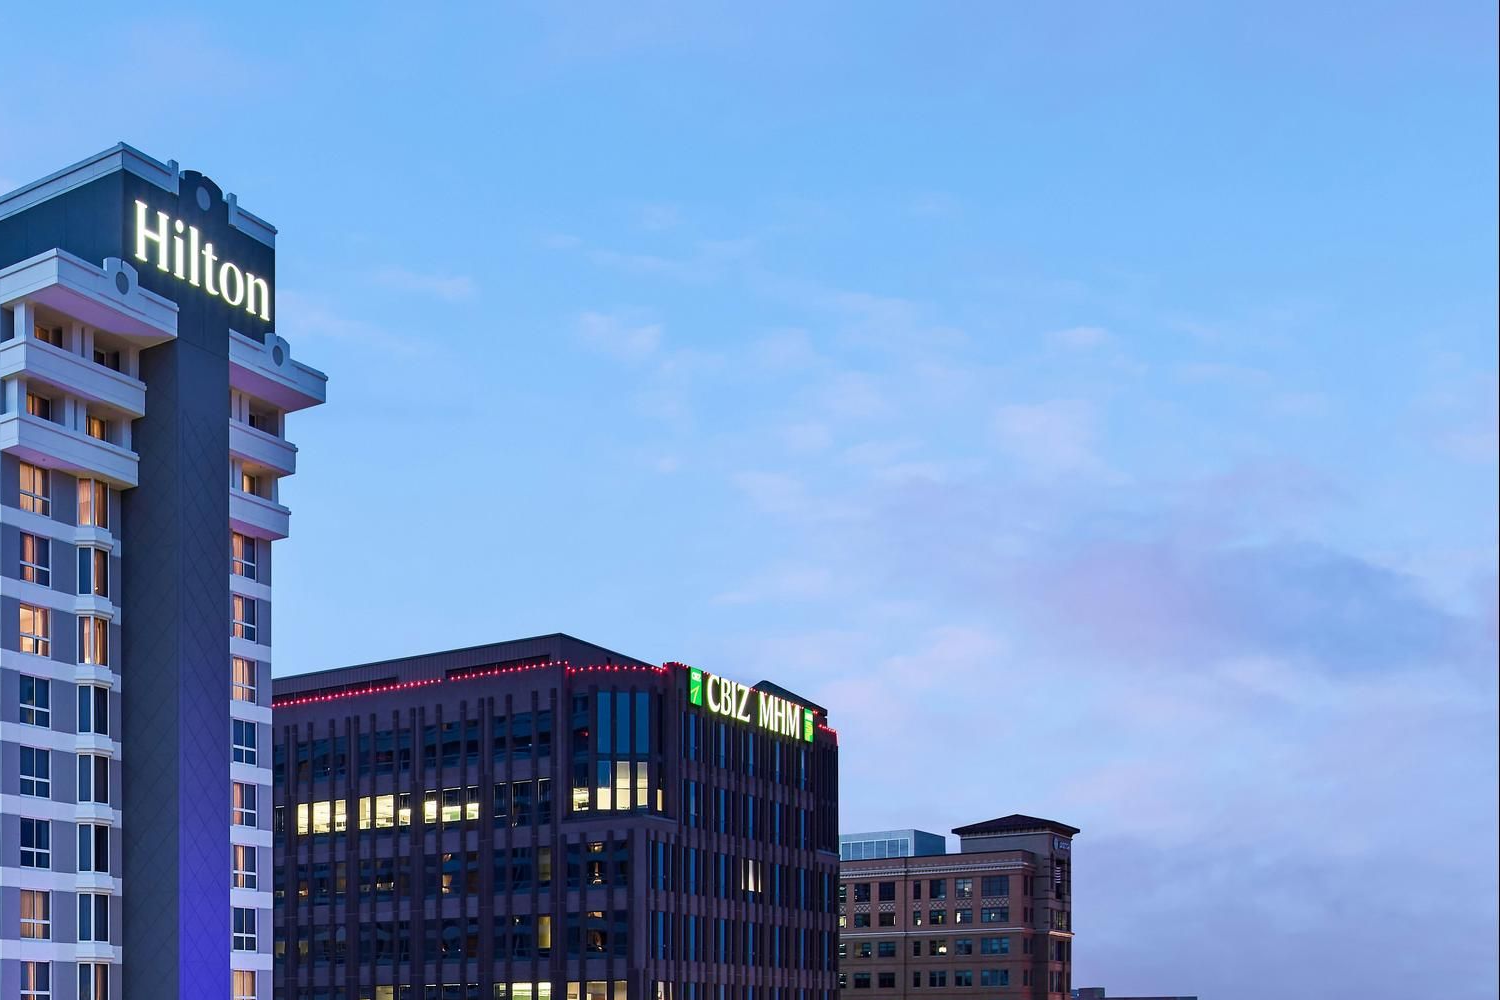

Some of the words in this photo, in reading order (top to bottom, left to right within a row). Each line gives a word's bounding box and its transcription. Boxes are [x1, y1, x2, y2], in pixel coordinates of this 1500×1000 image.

[135, 199, 270, 322] Hilton
[707, 674, 751, 723] CBIZ
[758, 690, 800, 740] MHM
